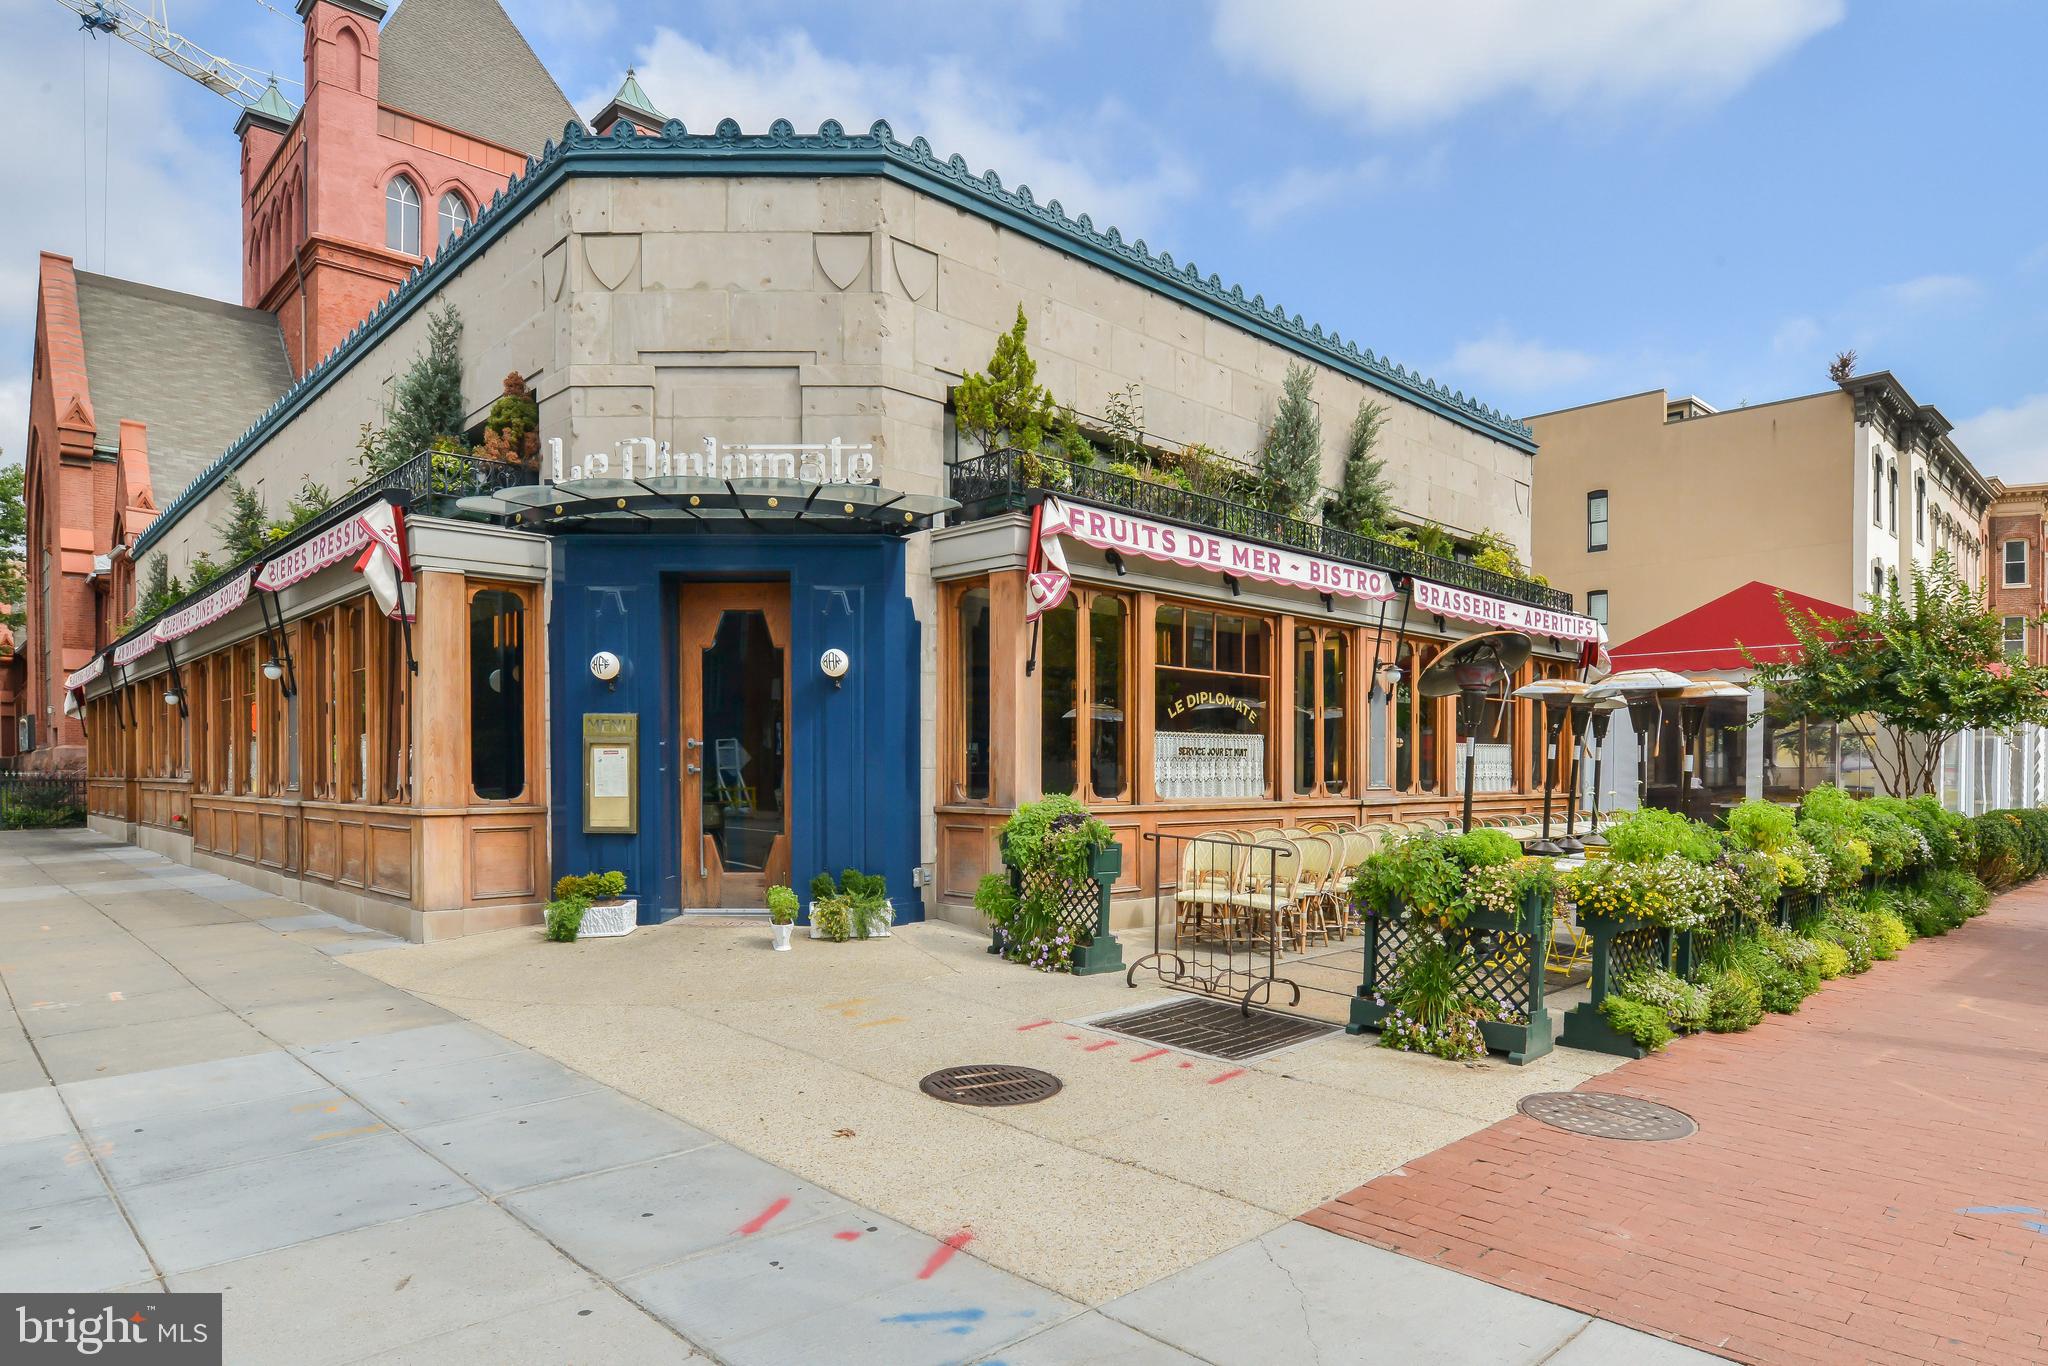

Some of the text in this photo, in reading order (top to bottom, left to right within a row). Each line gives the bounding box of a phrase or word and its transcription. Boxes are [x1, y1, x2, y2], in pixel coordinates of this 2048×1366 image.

[549, 437, 609, 485] Le
[1068, 507, 1177, 553] FRUITS
[1187, 534, 1222, 562] DE
[1232, 544, 1281, 575] MER
[1309, 560, 1381, 593] BISTRO
[1420, 584, 1506, 621] BRASSERIE
[1167, 691, 1258, 724] LE DIPLOMATE
[588, 719, 632, 734] MENU
[1178, 747, 1206, 757] SERVICE
[1207, 748, 1224, 757] JOUR
[1224, 748, 1233, 757] ET
